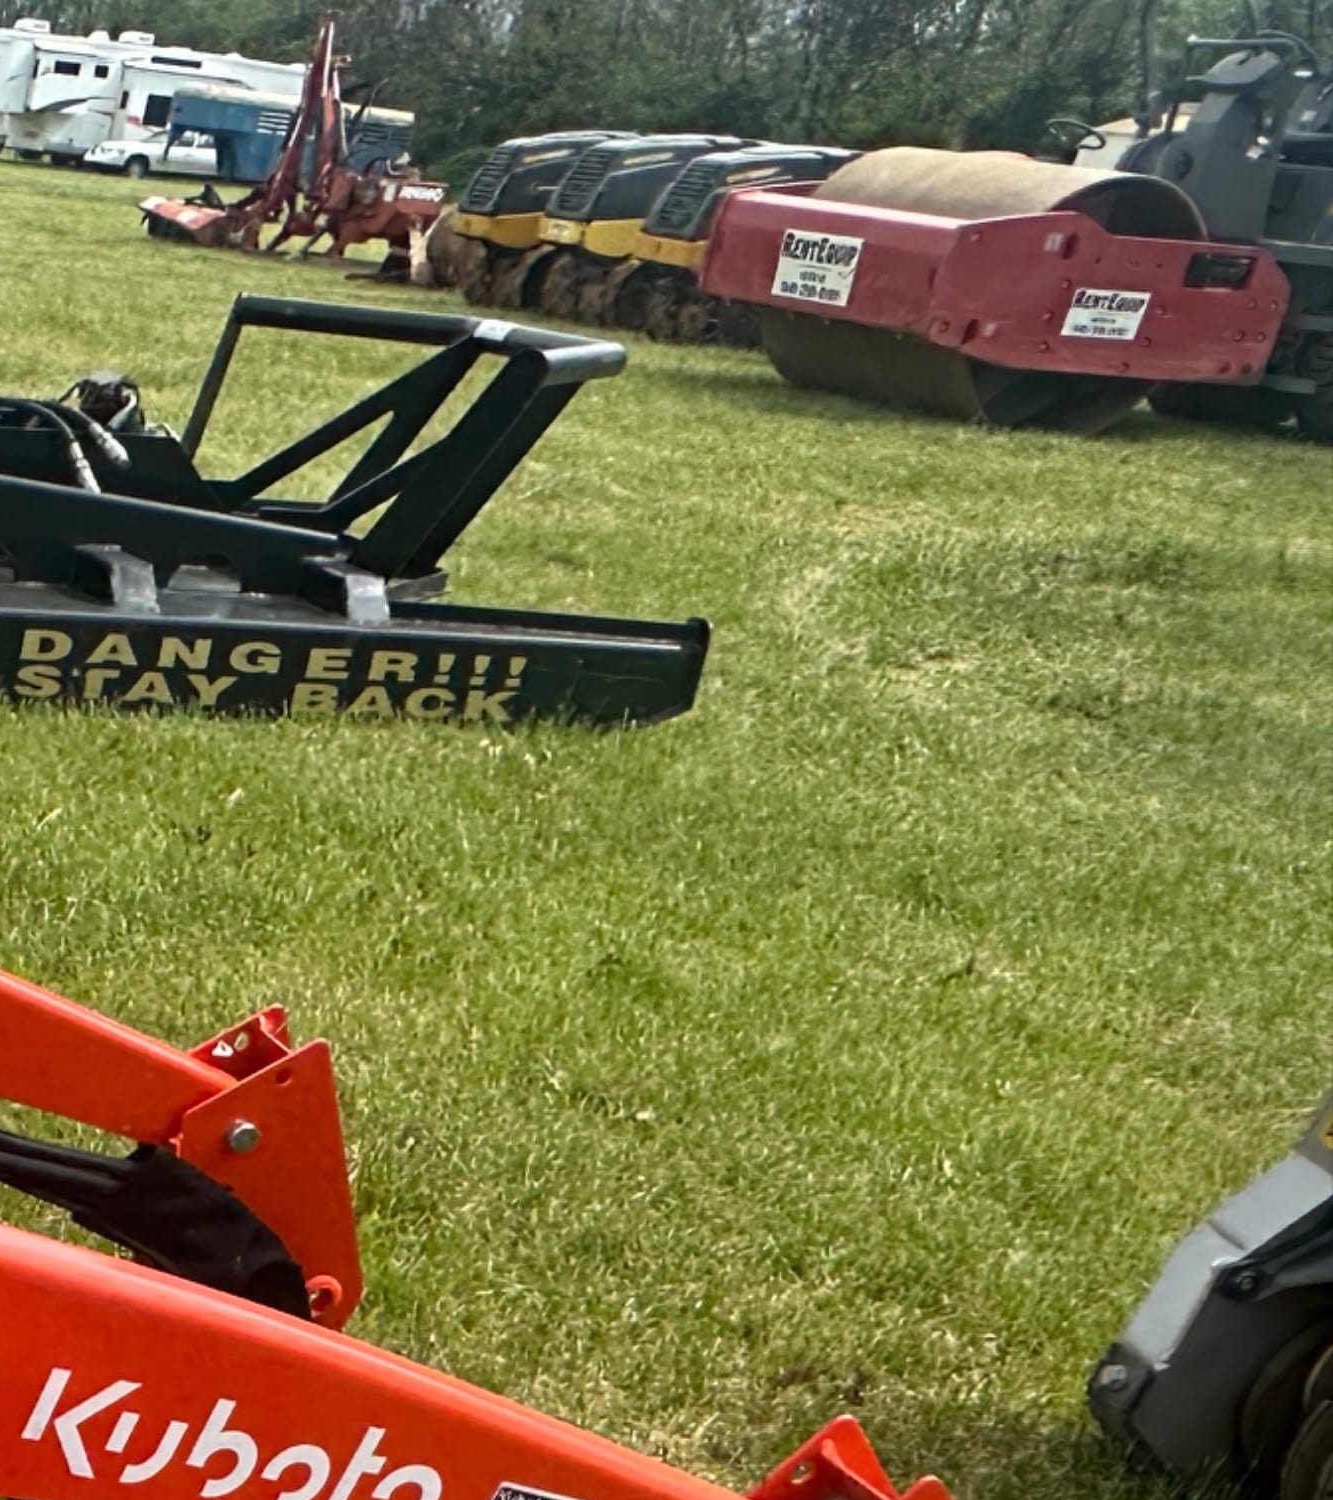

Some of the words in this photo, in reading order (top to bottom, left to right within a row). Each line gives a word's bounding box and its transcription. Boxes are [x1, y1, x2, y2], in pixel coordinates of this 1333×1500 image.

[19, 628, 528, 686] DANGER!!!
[14, 664, 237, 706] STAY
[291, 682, 521, 723] BACK
